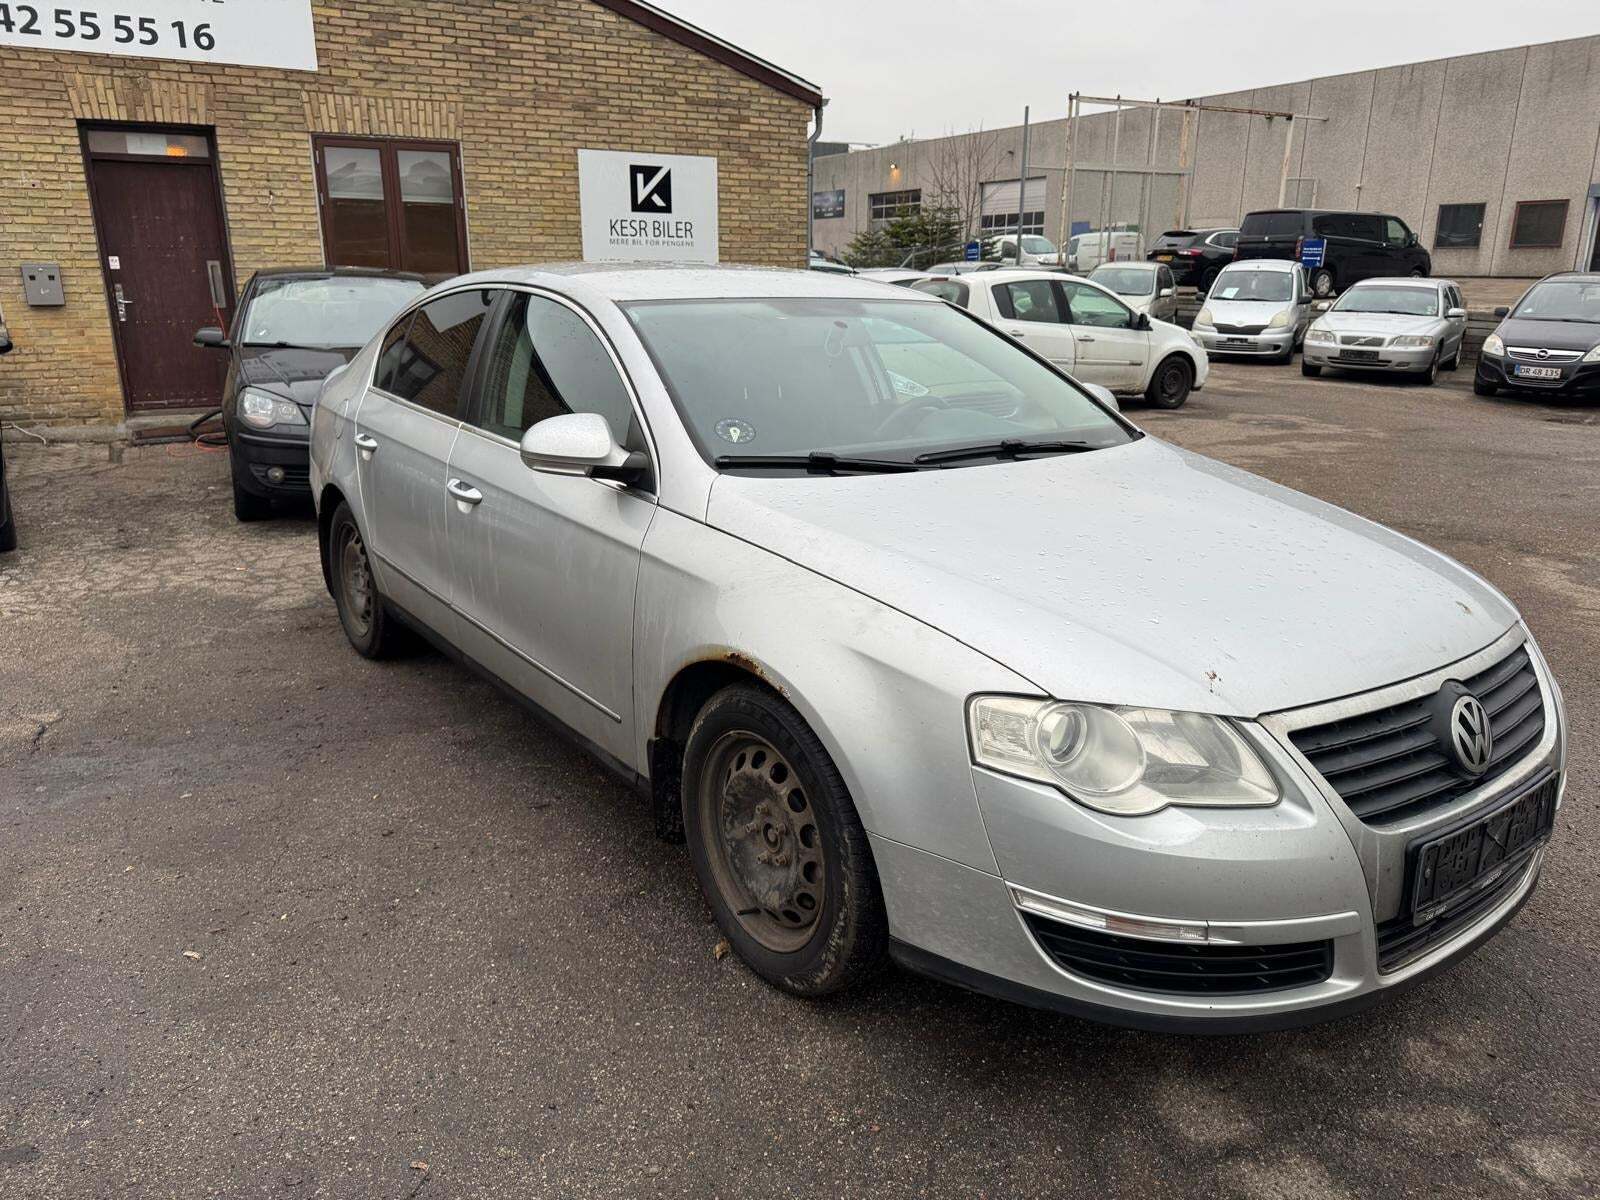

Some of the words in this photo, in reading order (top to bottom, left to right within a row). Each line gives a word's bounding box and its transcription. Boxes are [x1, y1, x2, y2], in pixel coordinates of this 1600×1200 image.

[54, 9, 100, 40] 55
[114, 14, 158, 46] 55
[171, 20, 215, 51] 16
[609, 218, 648, 237] KESR
[652, 220, 693, 239] BILER
[609, 238, 629, 246] MERE
[662, 240, 694, 248] PENGENE
